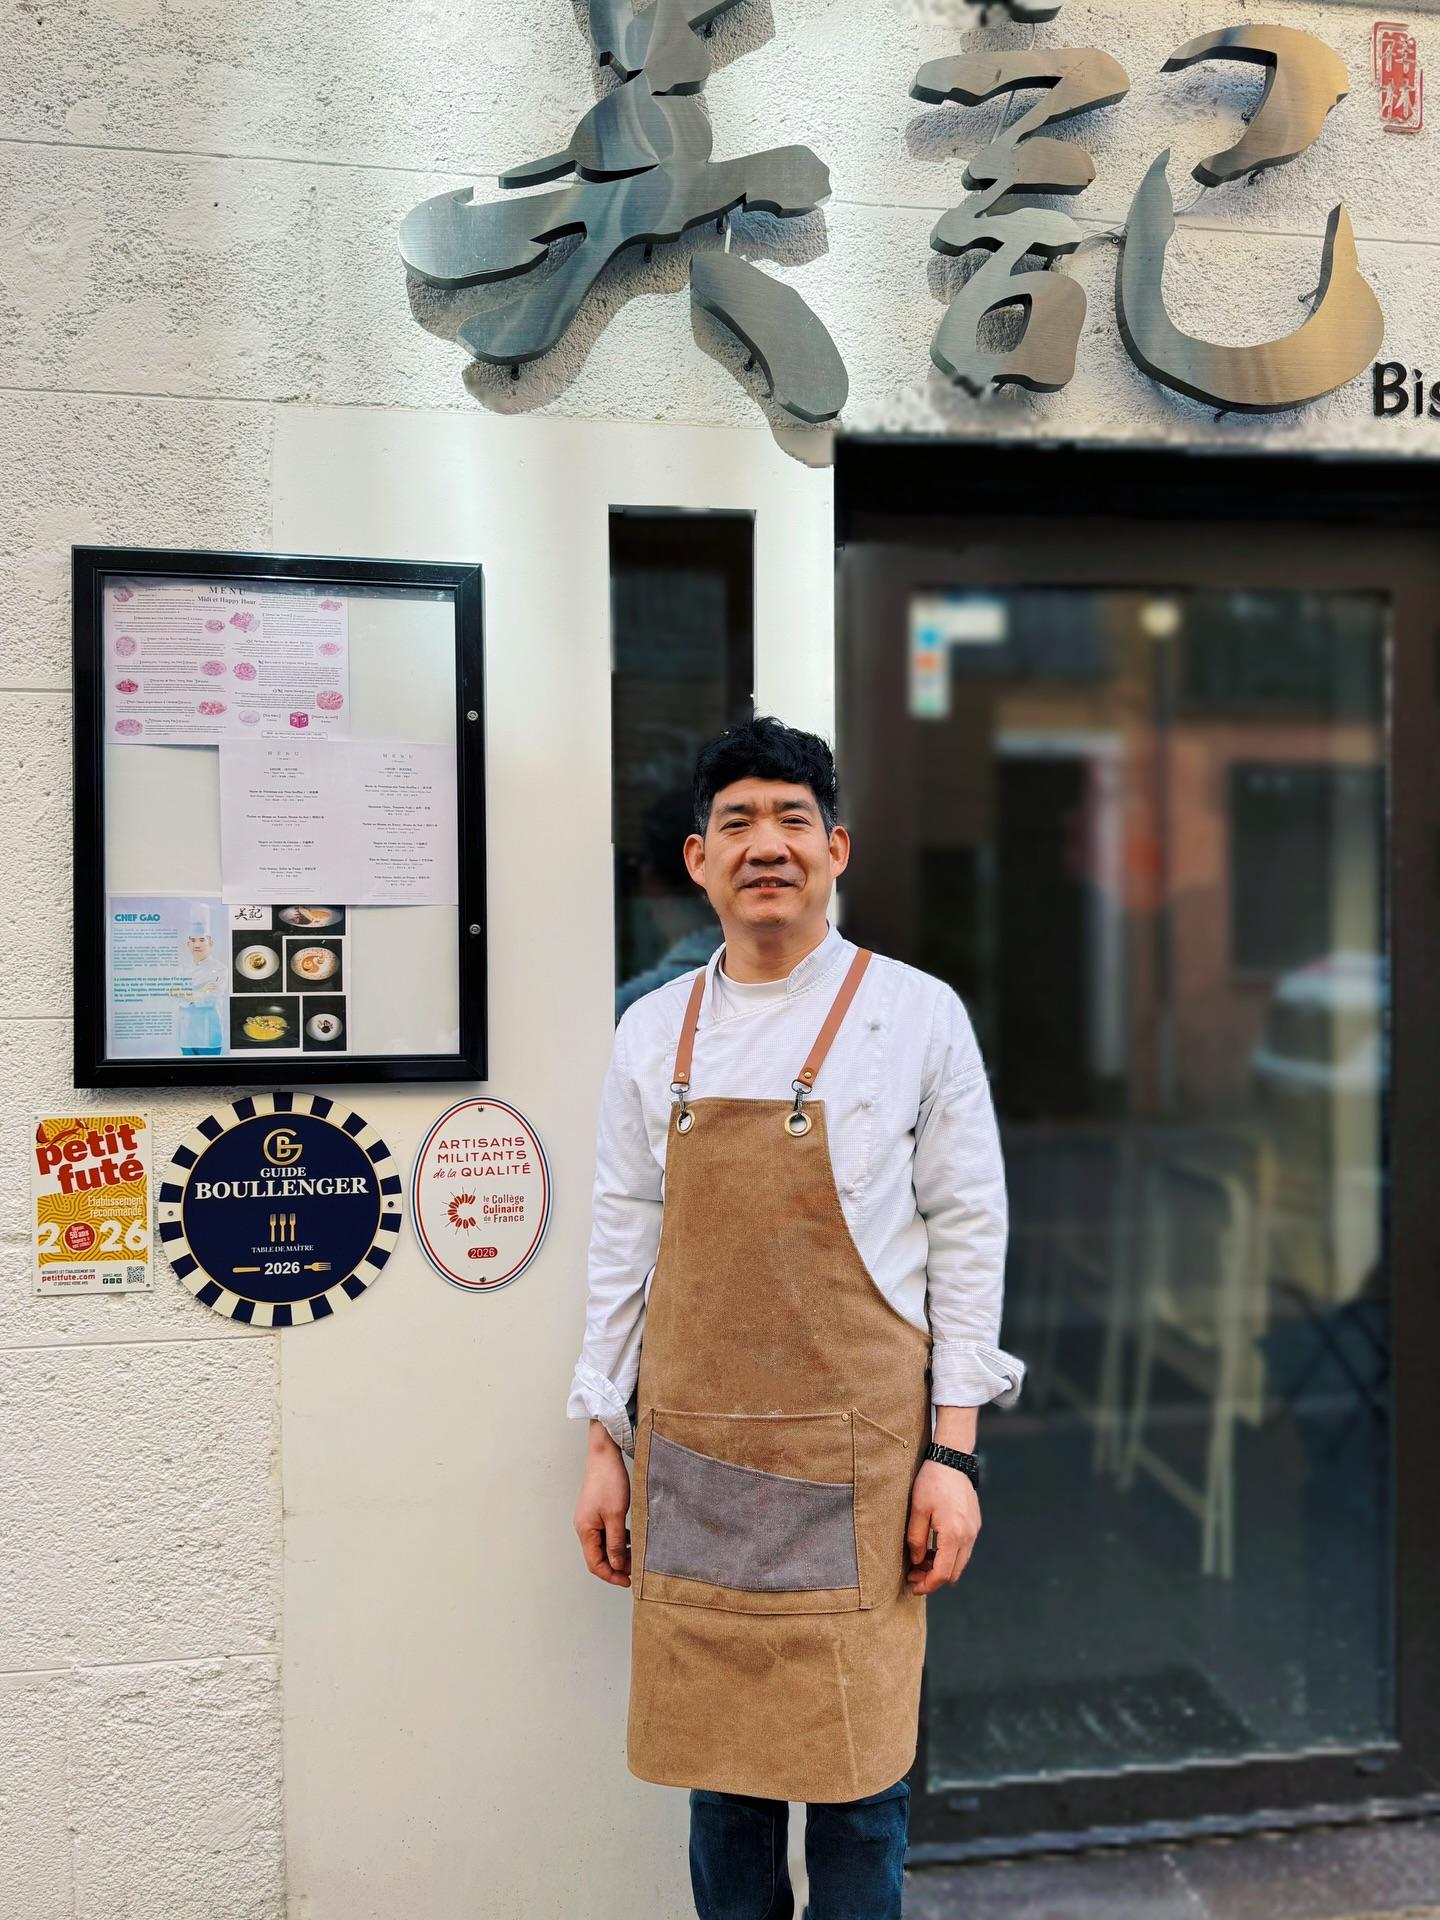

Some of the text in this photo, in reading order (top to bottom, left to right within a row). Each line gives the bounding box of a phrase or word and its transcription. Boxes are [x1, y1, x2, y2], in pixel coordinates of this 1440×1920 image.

[209, 586, 246, 595] MENU
[114, 913, 161, 922] CHEF GAO
[438, 1136, 526, 1150] ARTISANS
[35, 1123, 138, 1176] petit
[437, 1150, 527, 1164] MILITANTS
[57, 1153, 144, 1194] futé
[260, 1166, 306, 1178] GUIDE
[433, 1162, 531, 1179] de la QUALITÉ
[194, 1177, 369, 1200] BOULLENGER
[483, 1194, 525, 1205] le Collège
[90, 1205, 143, 1218] recommandé
[483, 1204, 524, 1214] Culinaire
[493, 1213, 525, 1223] France
[69, 1230, 90, 1239] 50 ans
[251, 1243, 314, 1254] TABLE DE MAÎTRE
[470, 1248, 496, 1258] 2026
[264, 1261, 300, 1275] 2026
[41, 1273, 96, 1283] petitfute.com
